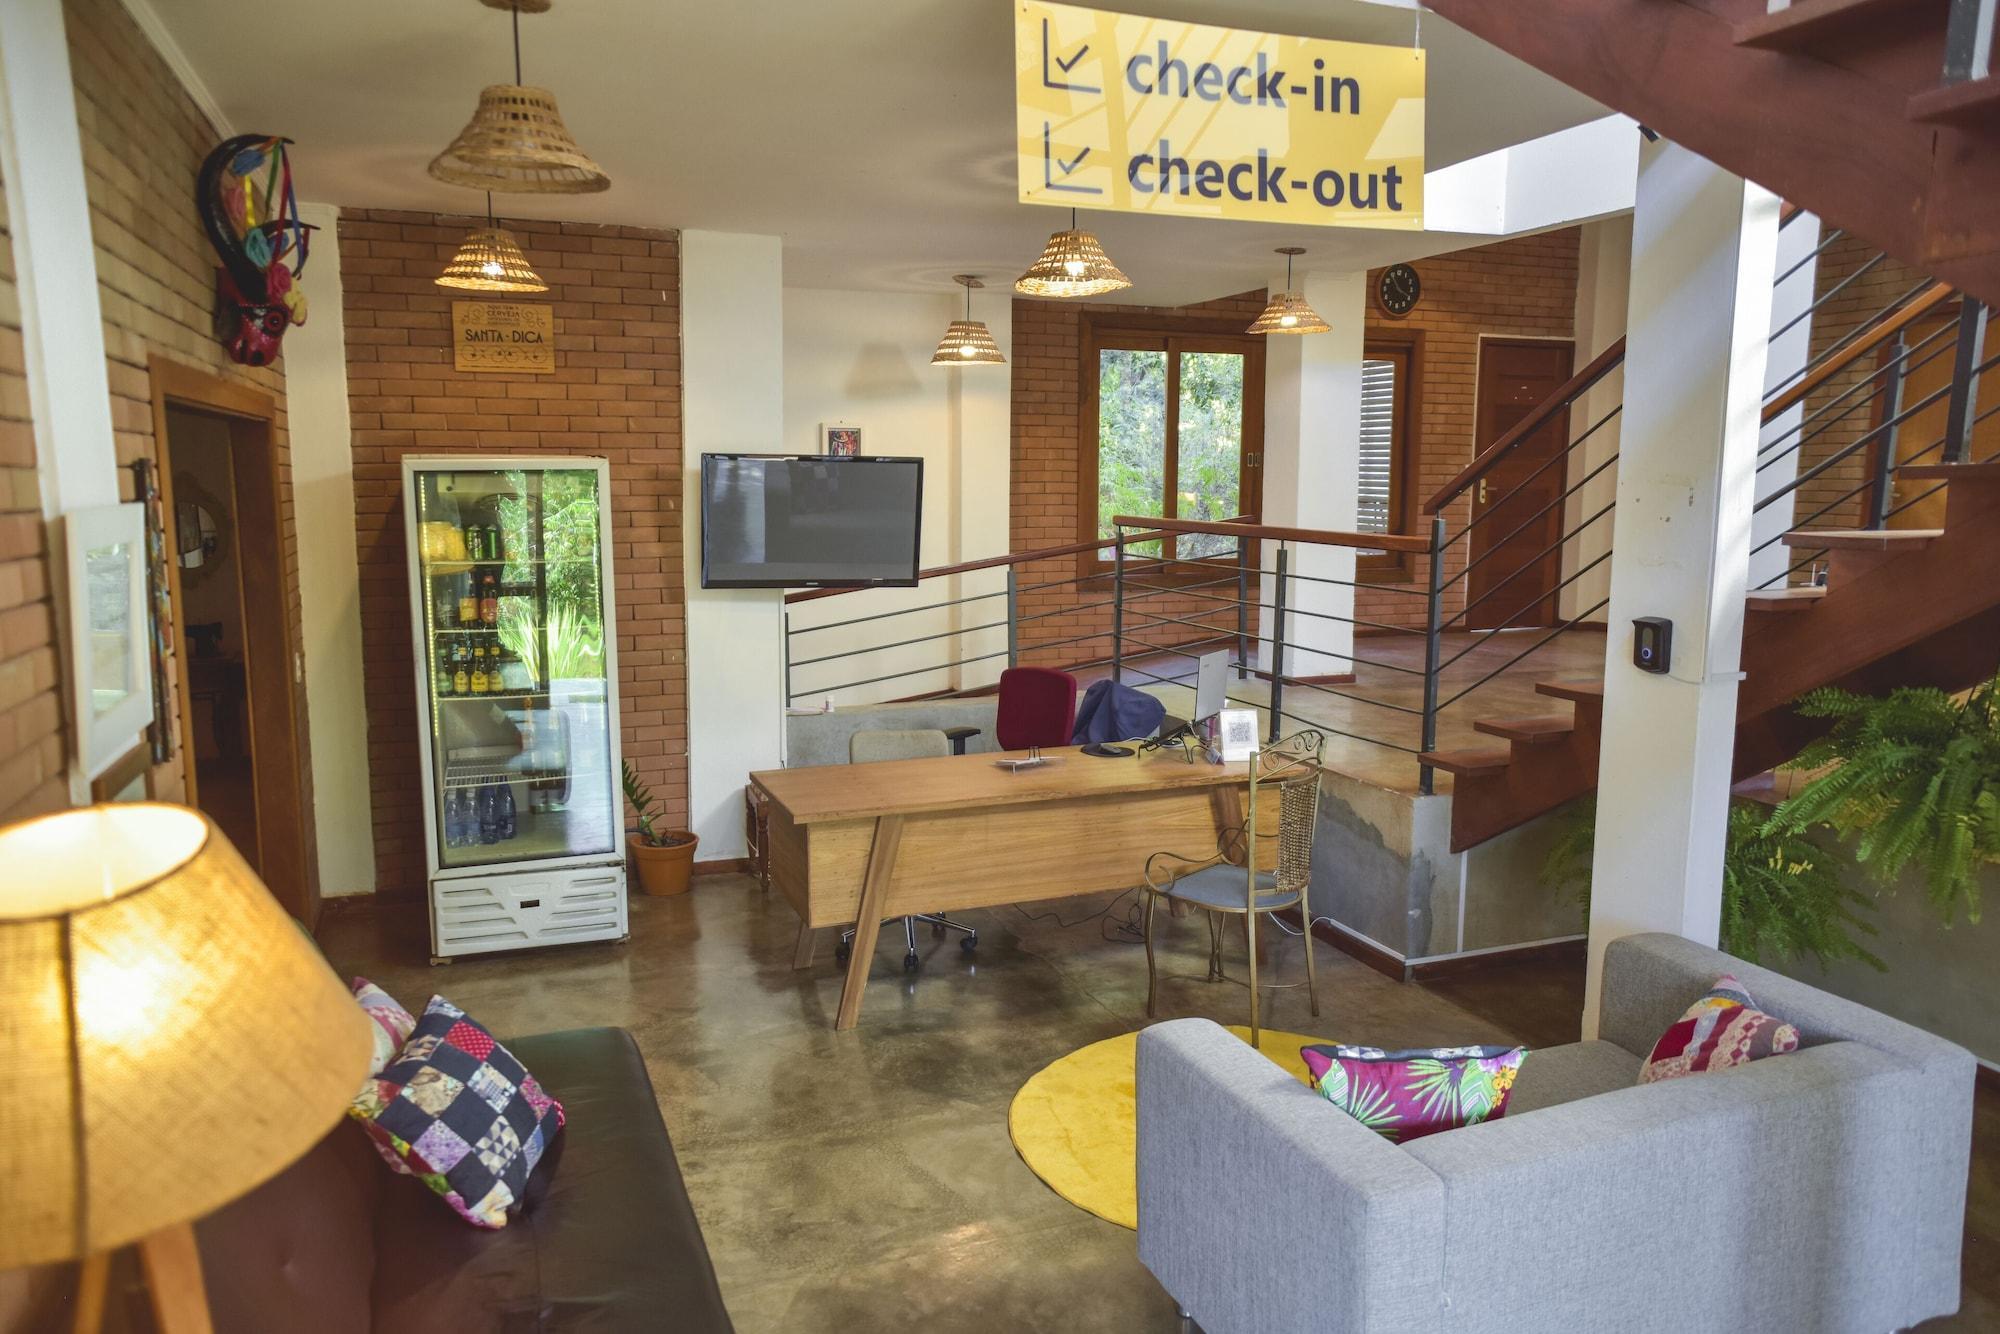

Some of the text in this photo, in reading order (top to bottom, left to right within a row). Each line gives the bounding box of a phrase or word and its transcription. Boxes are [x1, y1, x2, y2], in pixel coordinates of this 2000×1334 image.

[1126, 40, 1360, 115] check-in
[1128, 139, 1402, 212] check-out
[487, 310, 520, 318] CERVEJA
[465, 329, 543, 344] SANTA DICA
